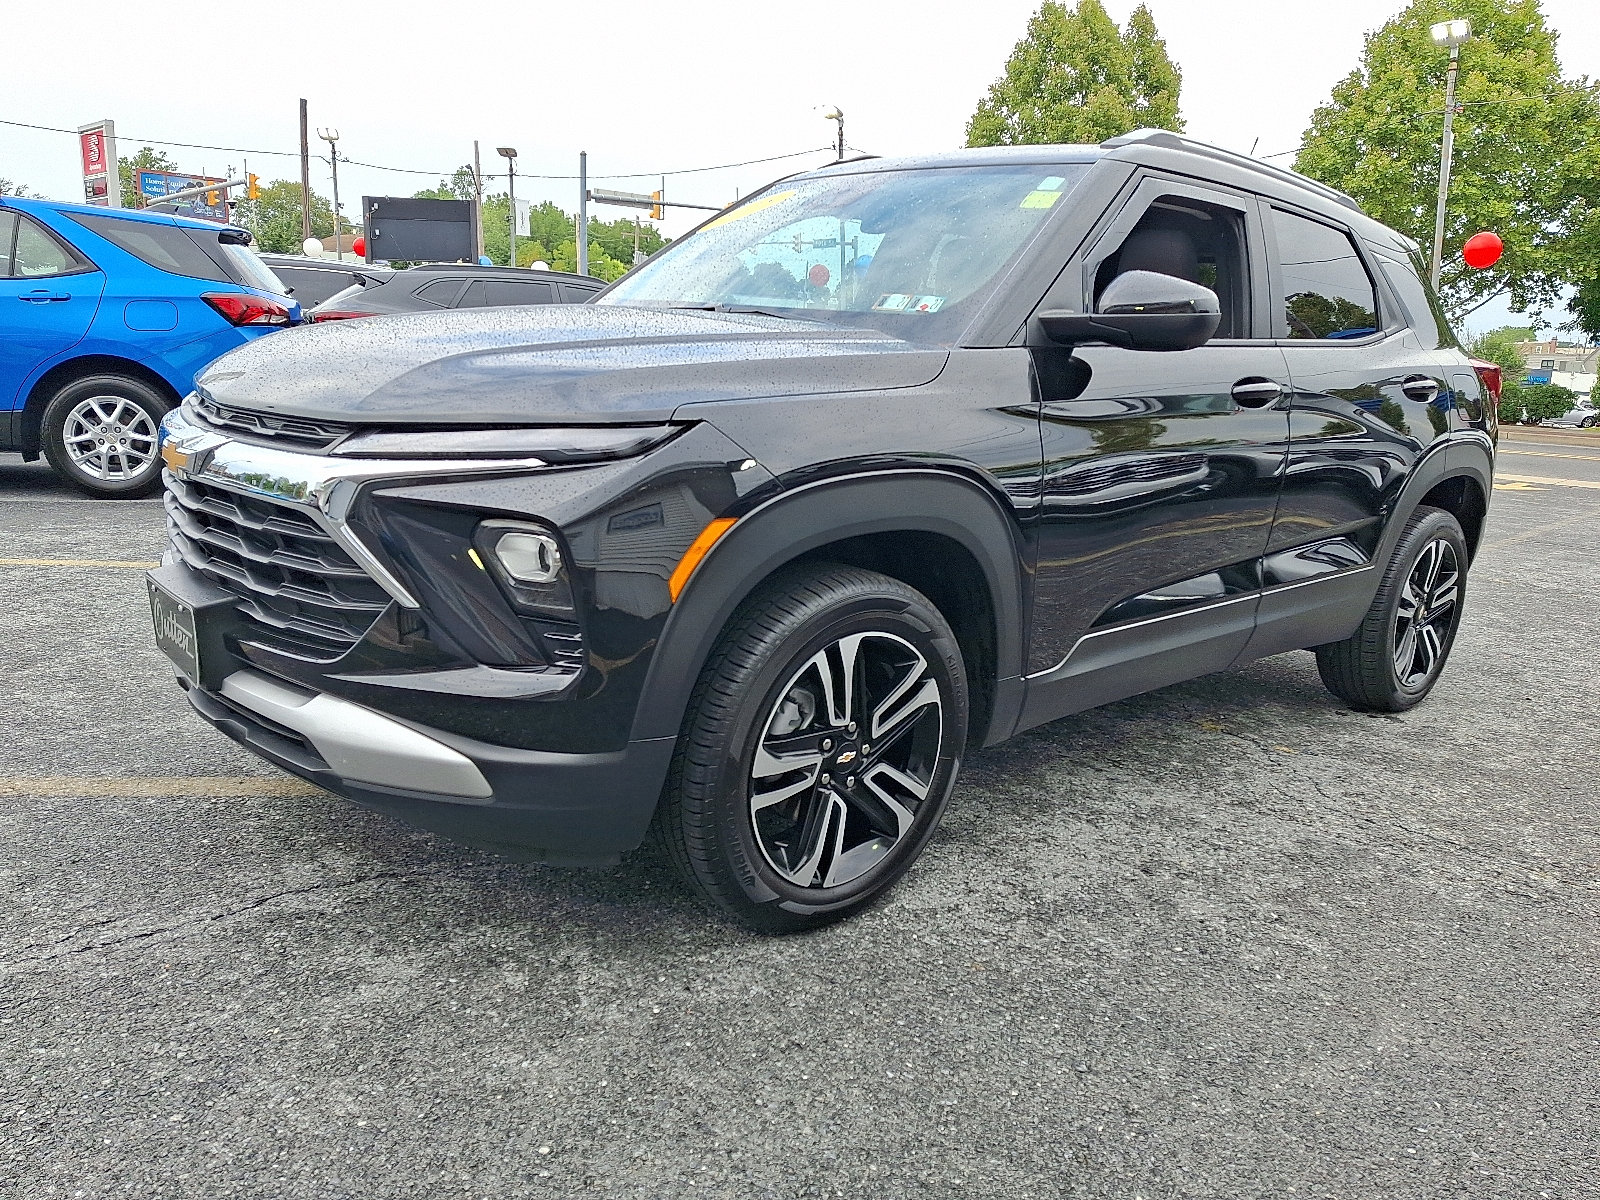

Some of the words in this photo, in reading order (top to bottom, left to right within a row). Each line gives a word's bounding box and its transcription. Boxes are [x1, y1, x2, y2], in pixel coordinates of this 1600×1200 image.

[145, 178, 165, 186] Home
[146, 185, 177, 194] Solutins
[154, 597, 194, 659] Outten
